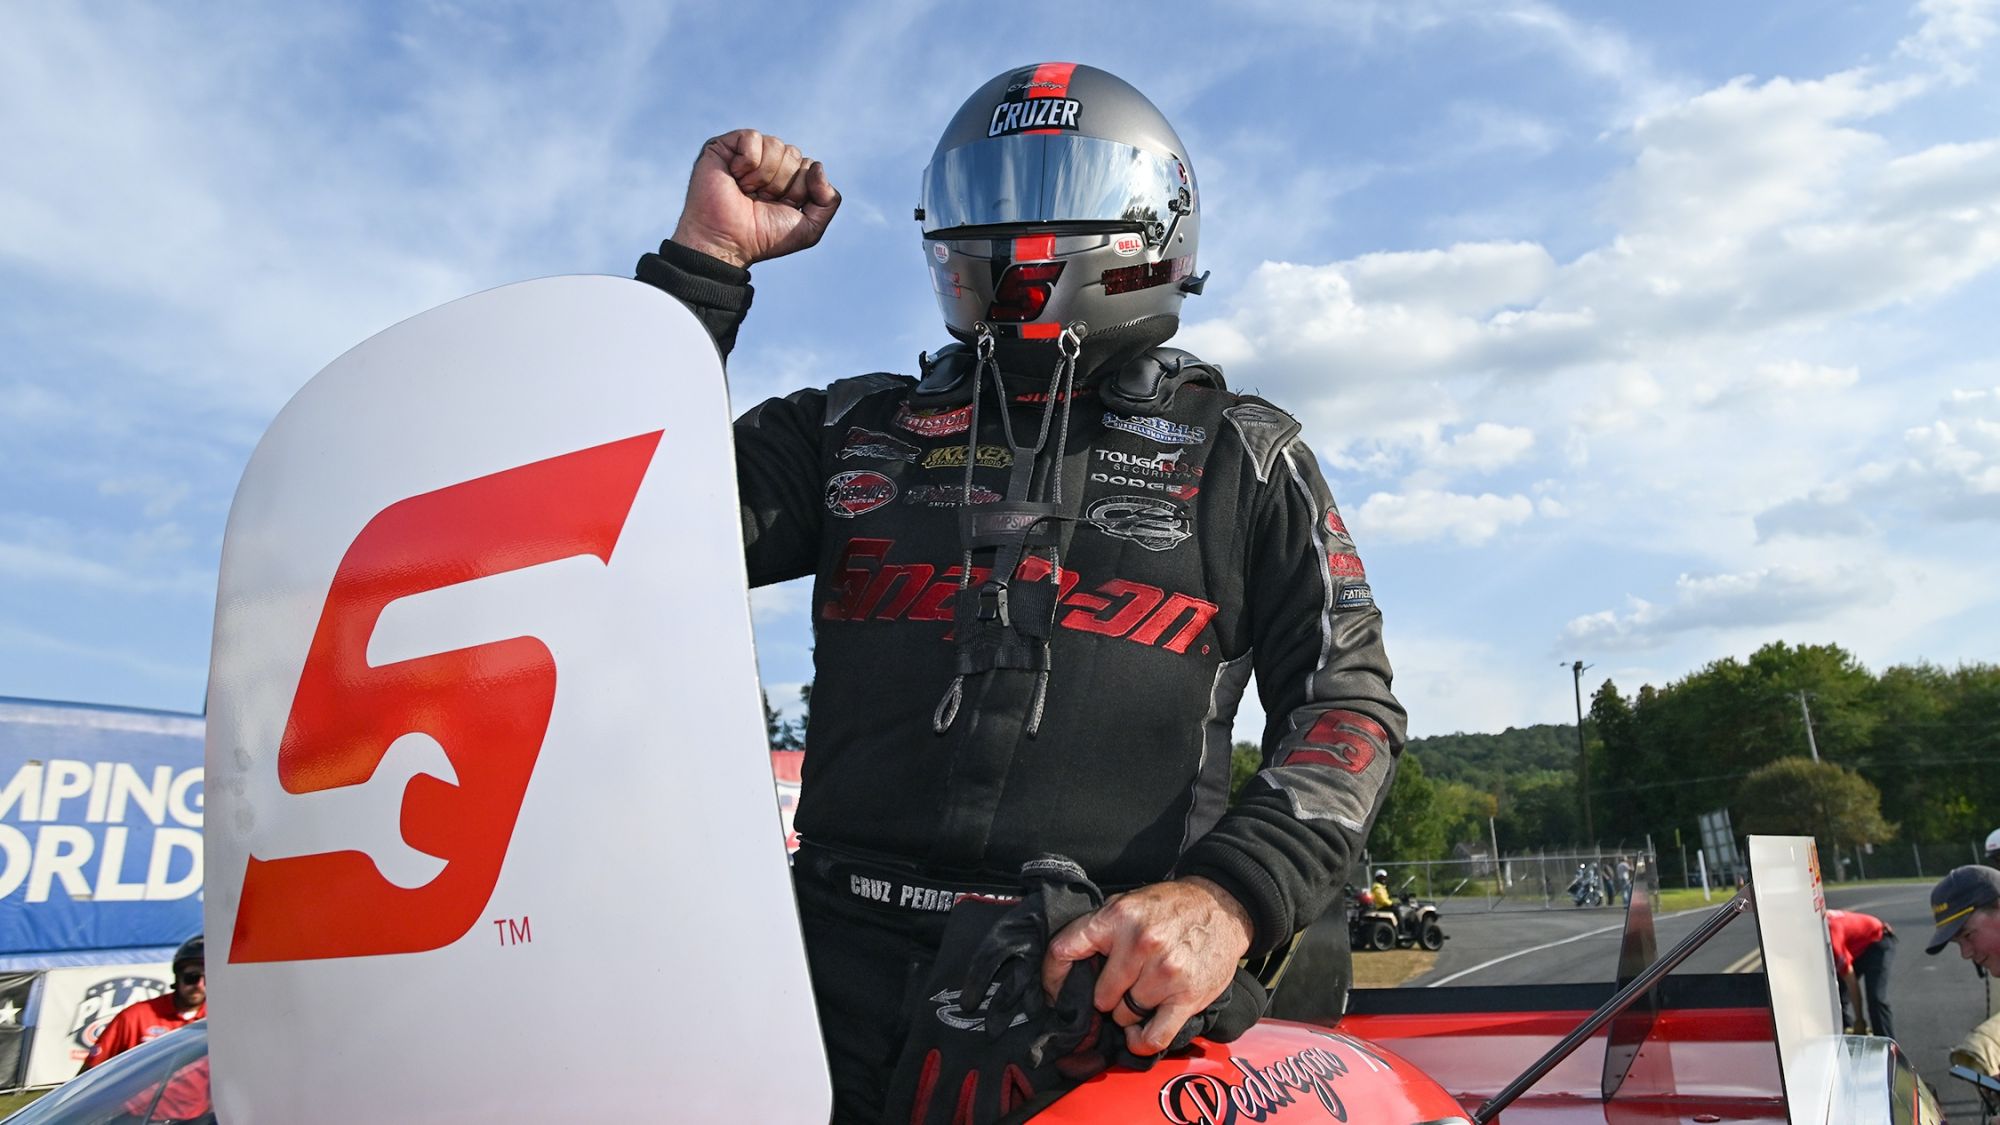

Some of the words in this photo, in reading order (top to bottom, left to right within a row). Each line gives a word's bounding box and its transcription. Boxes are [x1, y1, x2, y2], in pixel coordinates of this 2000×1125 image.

[988, 99, 1080, 137] CRUZER
[1118, 239, 1140, 250] BELL
[1091, 473, 1183, 494] DODGE
[1113, 462, 1181, 479] SECURITY
[851, 874, 892, 903] CRUZ
[899, 885, 1013, 913] PEDR
[493, 916, 532, 947] TM
[1158, 1046, 1348, 1125] Pedregon
